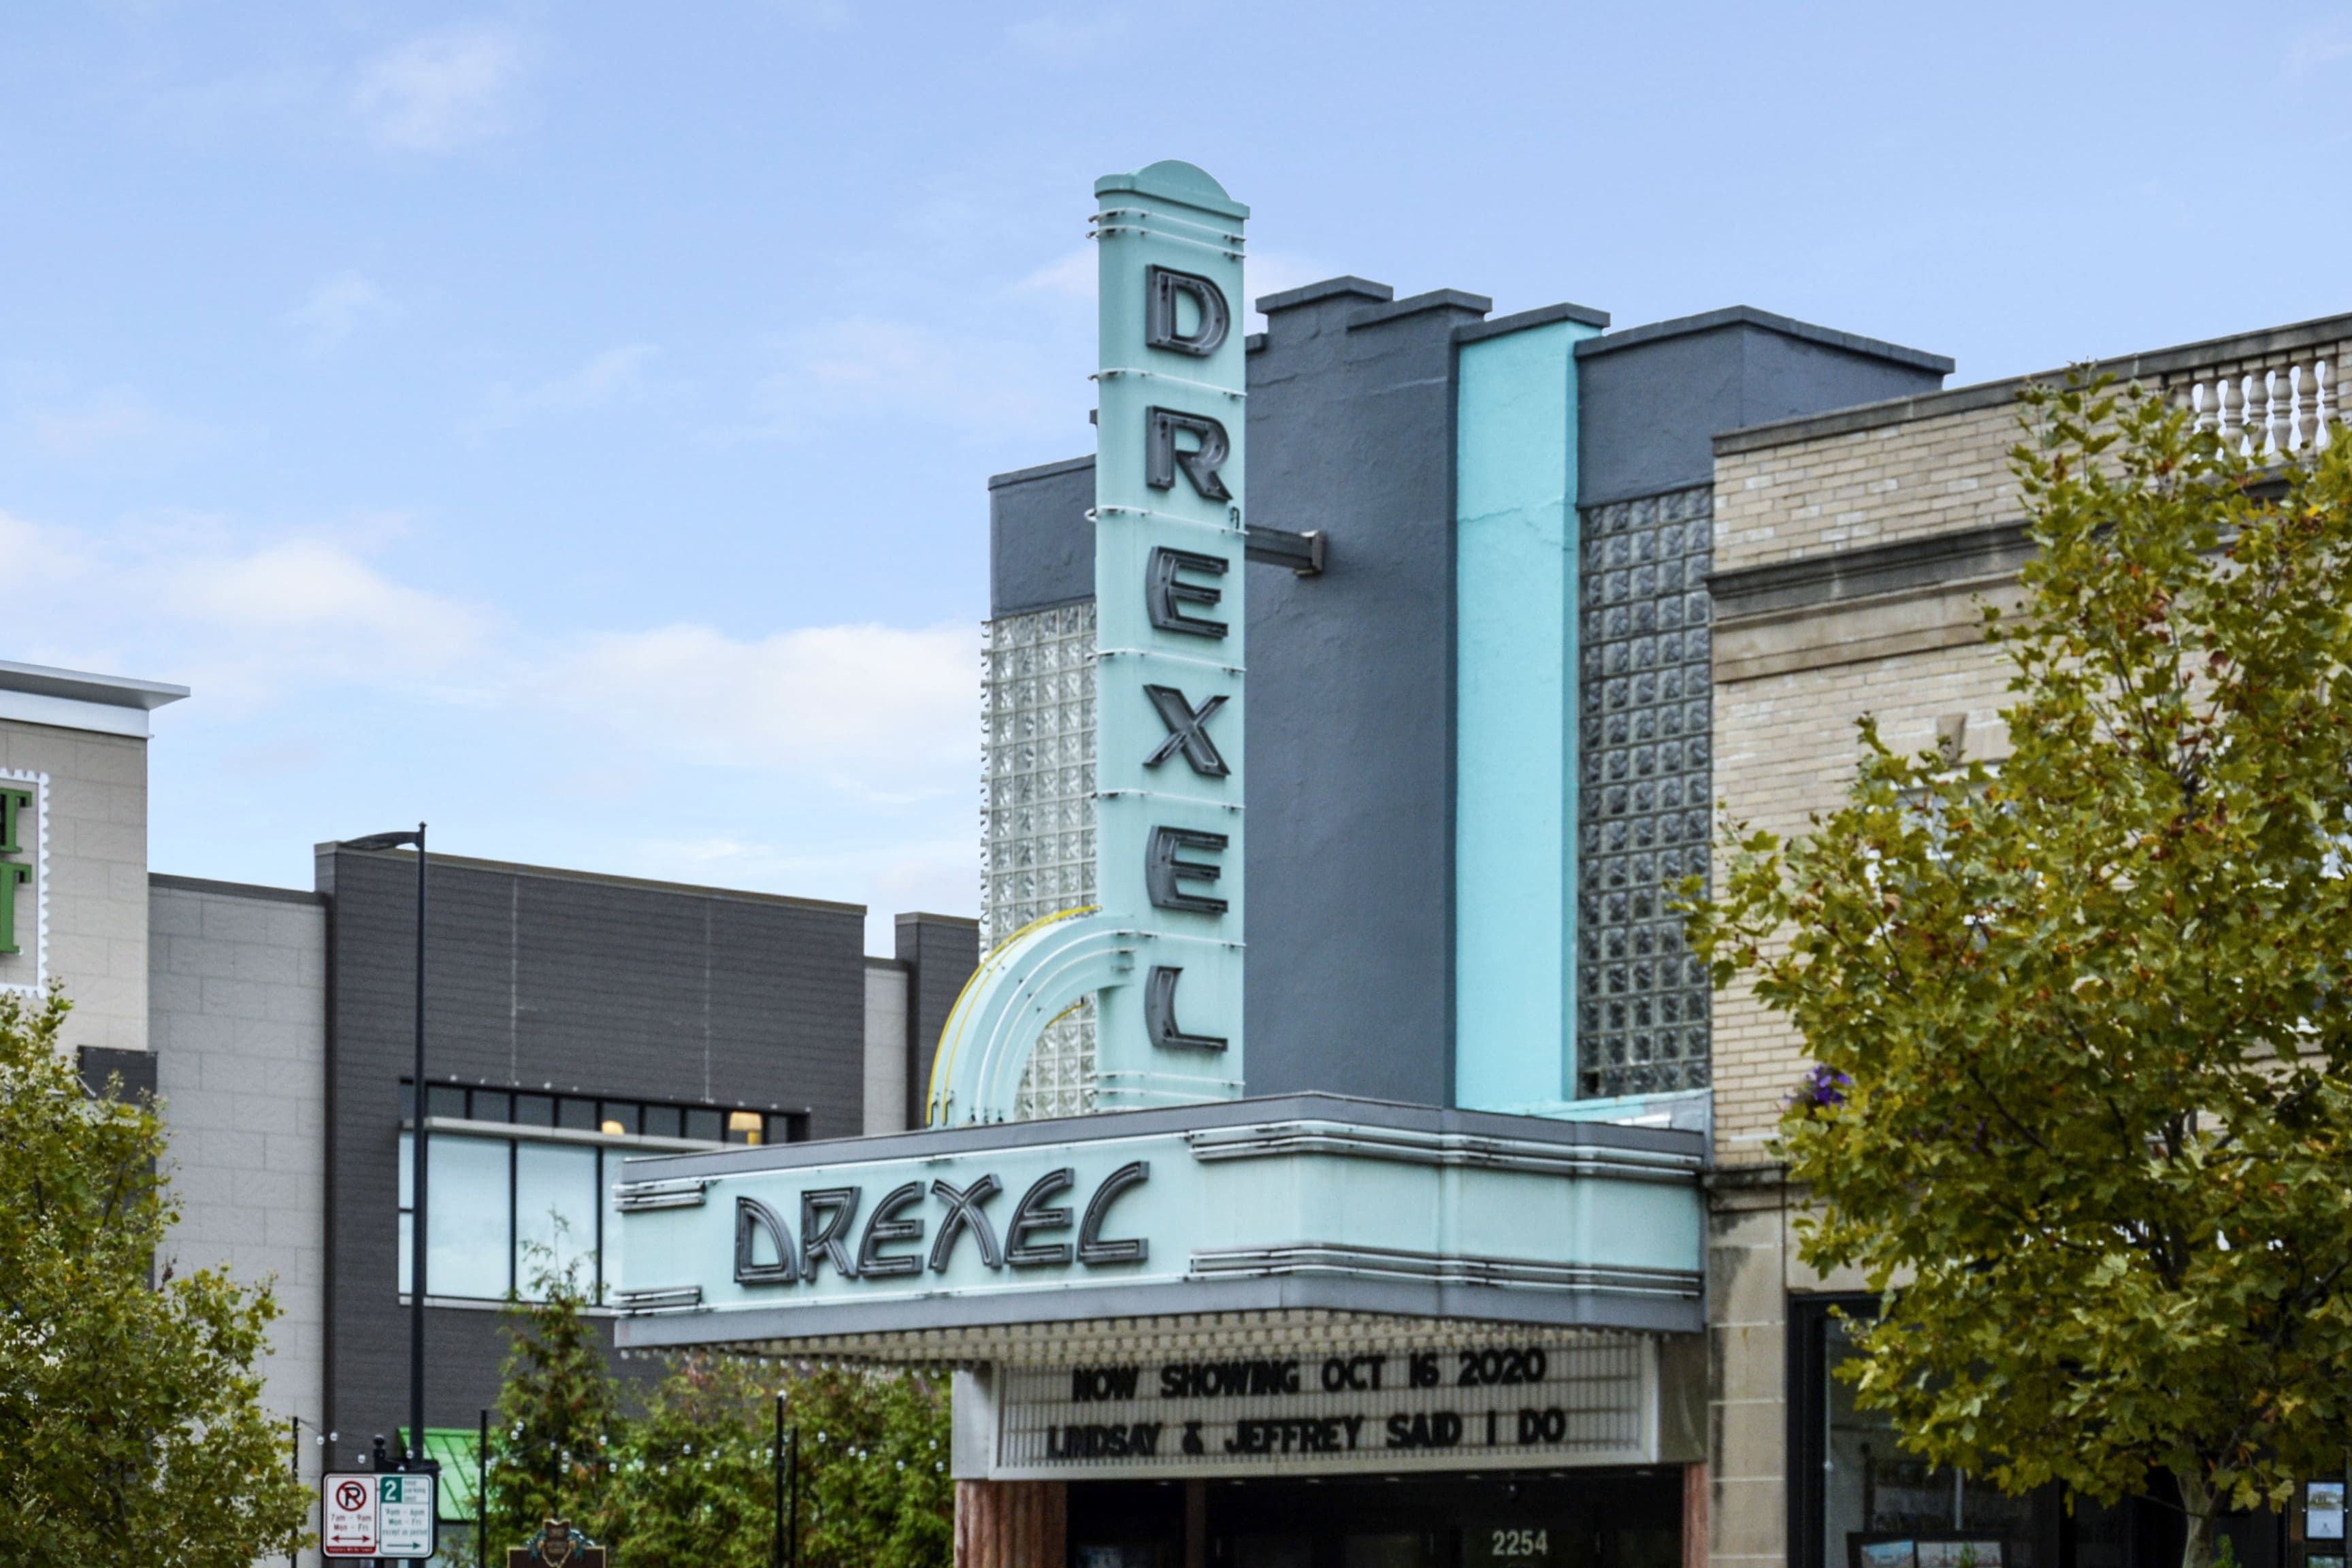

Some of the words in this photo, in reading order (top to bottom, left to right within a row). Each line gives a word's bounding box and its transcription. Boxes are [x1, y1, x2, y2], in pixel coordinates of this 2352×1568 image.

[1143, 263, 1232, 1052] DREXEL
[734, 1160, 1149, 1284] DREXEL
[1073, 1366, 1140, 1402] NOW
[1160, 1360, 1301, 1399] SHOWING
[1322, 1355, 1386, 1392] OCT
[1409, 1350, 1440, 1388] 16
[1458, 1347, 1547, 1387] 2020
[1046, 1422, 1163, 1458] LINDSAY
[1224, 1415, 1365, 1454] JEFFREY
[1386, 1411, 1463, 1449] SAID
[1487, 1410, 1496, 1446] I
[1518, 1407, 1566, 1445] DO
[385, 1480, 397, 1501] 2
[331, 1514, 346, 1522] 7am
[357, 1514, 372, 1522] 9am
[1492, 1529, 1548, 1556] 2254
